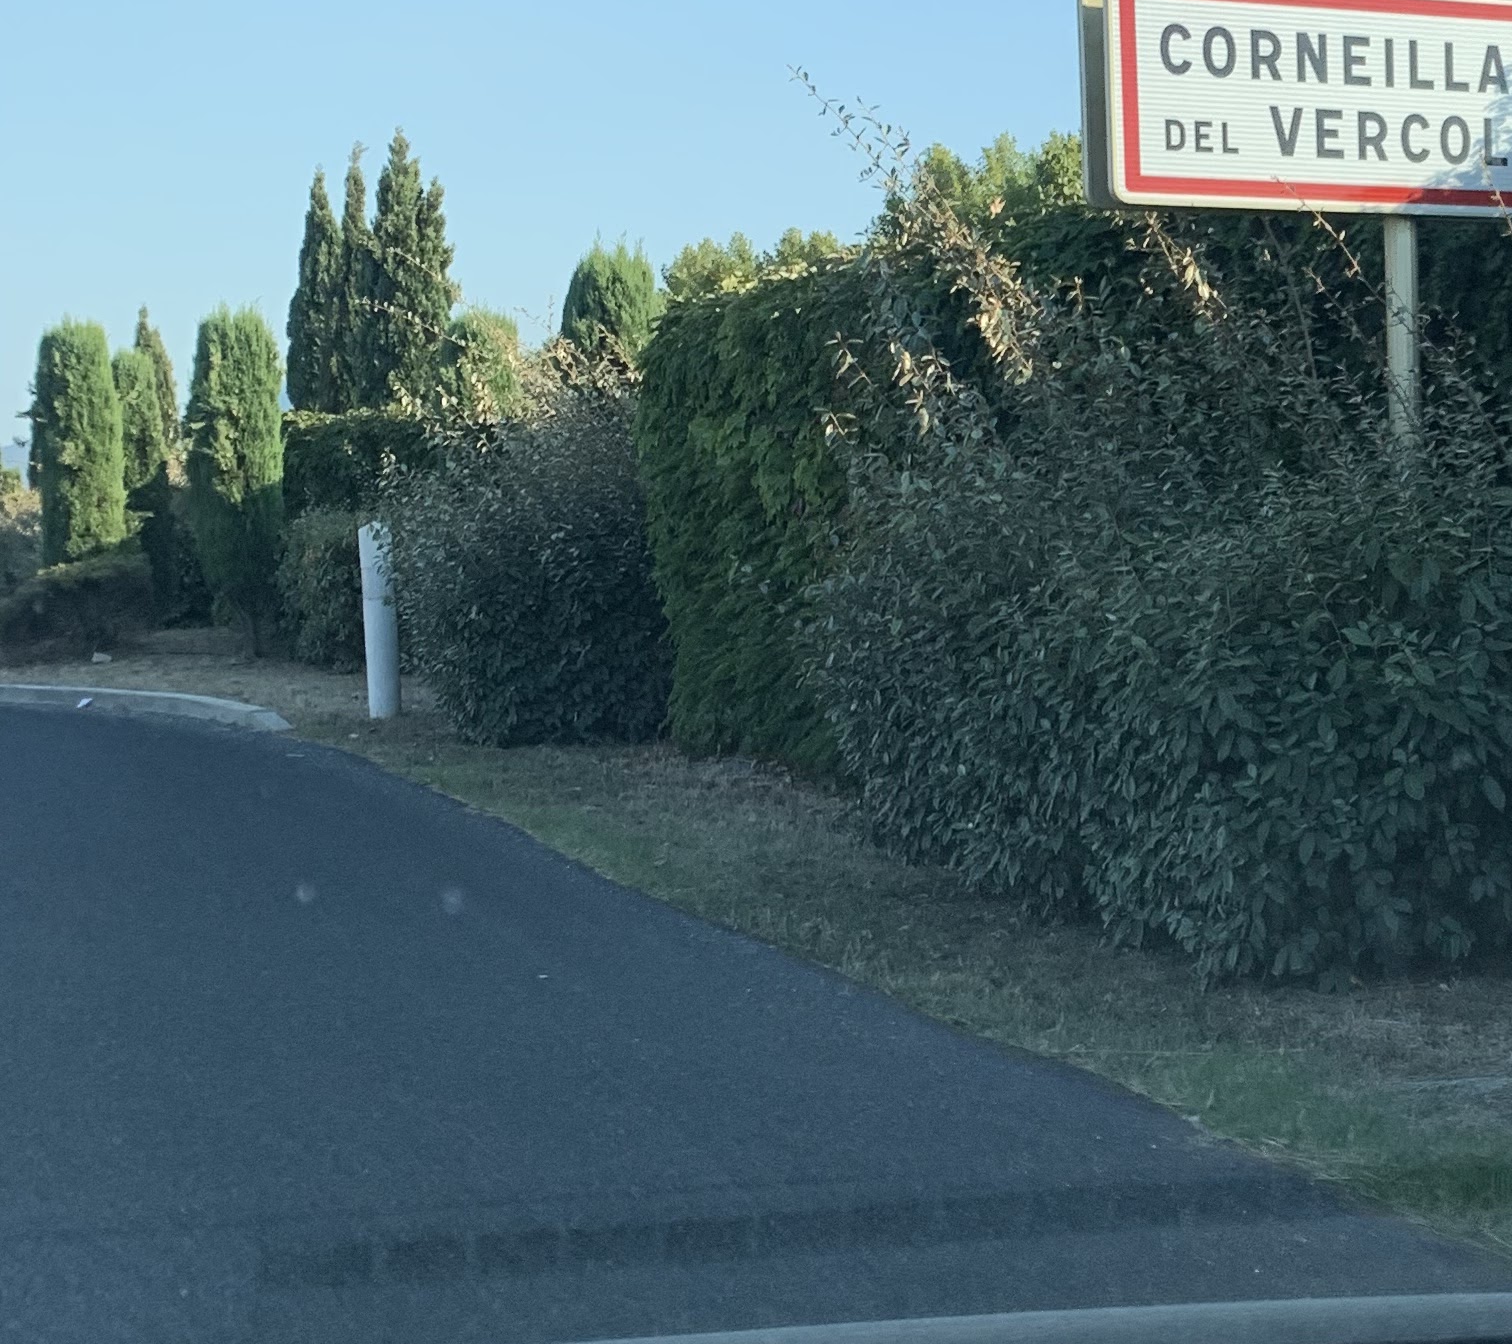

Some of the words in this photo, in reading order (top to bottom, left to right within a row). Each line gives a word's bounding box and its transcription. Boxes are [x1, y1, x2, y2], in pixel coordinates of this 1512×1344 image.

[1159, 23, 1510, 94] CORNEILLA
[1164, 118, 1240, 154] DEL
[1269, 105, 1509, 167] VERCOL
